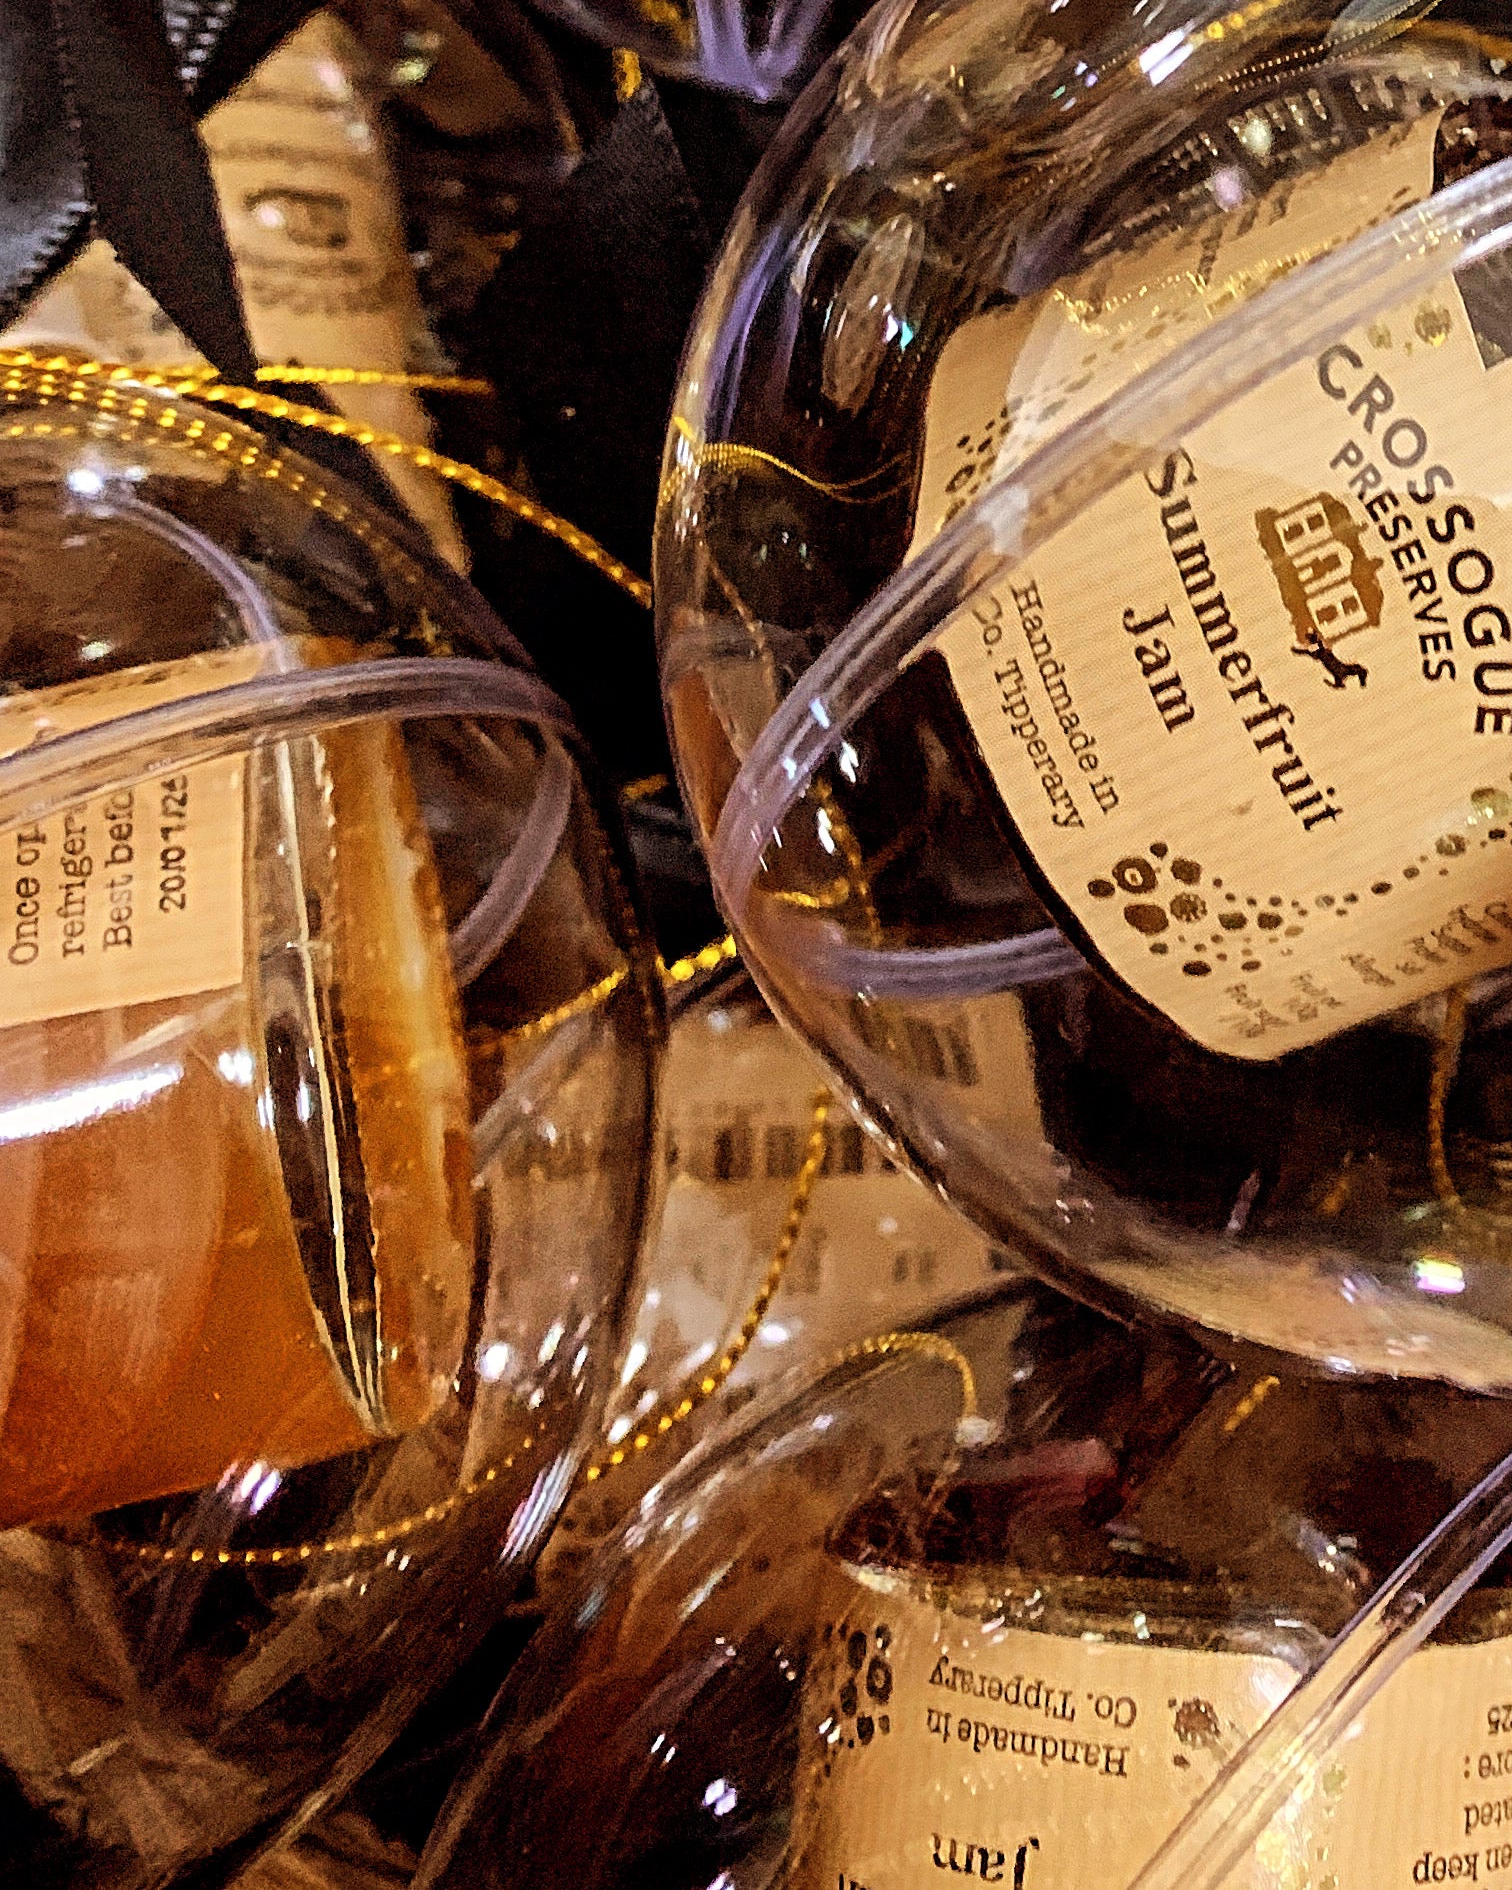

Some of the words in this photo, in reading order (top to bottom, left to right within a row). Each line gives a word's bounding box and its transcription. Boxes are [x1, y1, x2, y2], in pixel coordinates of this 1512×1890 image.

[1329, 438, 1456, 682] PRESERVES
[1122, 604, 1196, 735] Jam
[1145, 447, 1344, 831] Summerfruit
[1011, 578, 1100, 773] Handmade
[1089, 774, 1121, 815] in
[995, 659, 1087, 830] Tipperary
[103, 787, 136, 871] befo
[8, 877, 42, 966] Once
[103, 873, 134, 953] Best
[926, 1707, 952, 1744] in
[928, 1654, 1077, 1723] Tipperary
[1085, 1692, 1138, 1729] Co.
[957, 1717, 1131, 1778] Handmade
[930, 1832, 1041, 1890] Jam
[1412, 1850, 1480, 1886] keep
